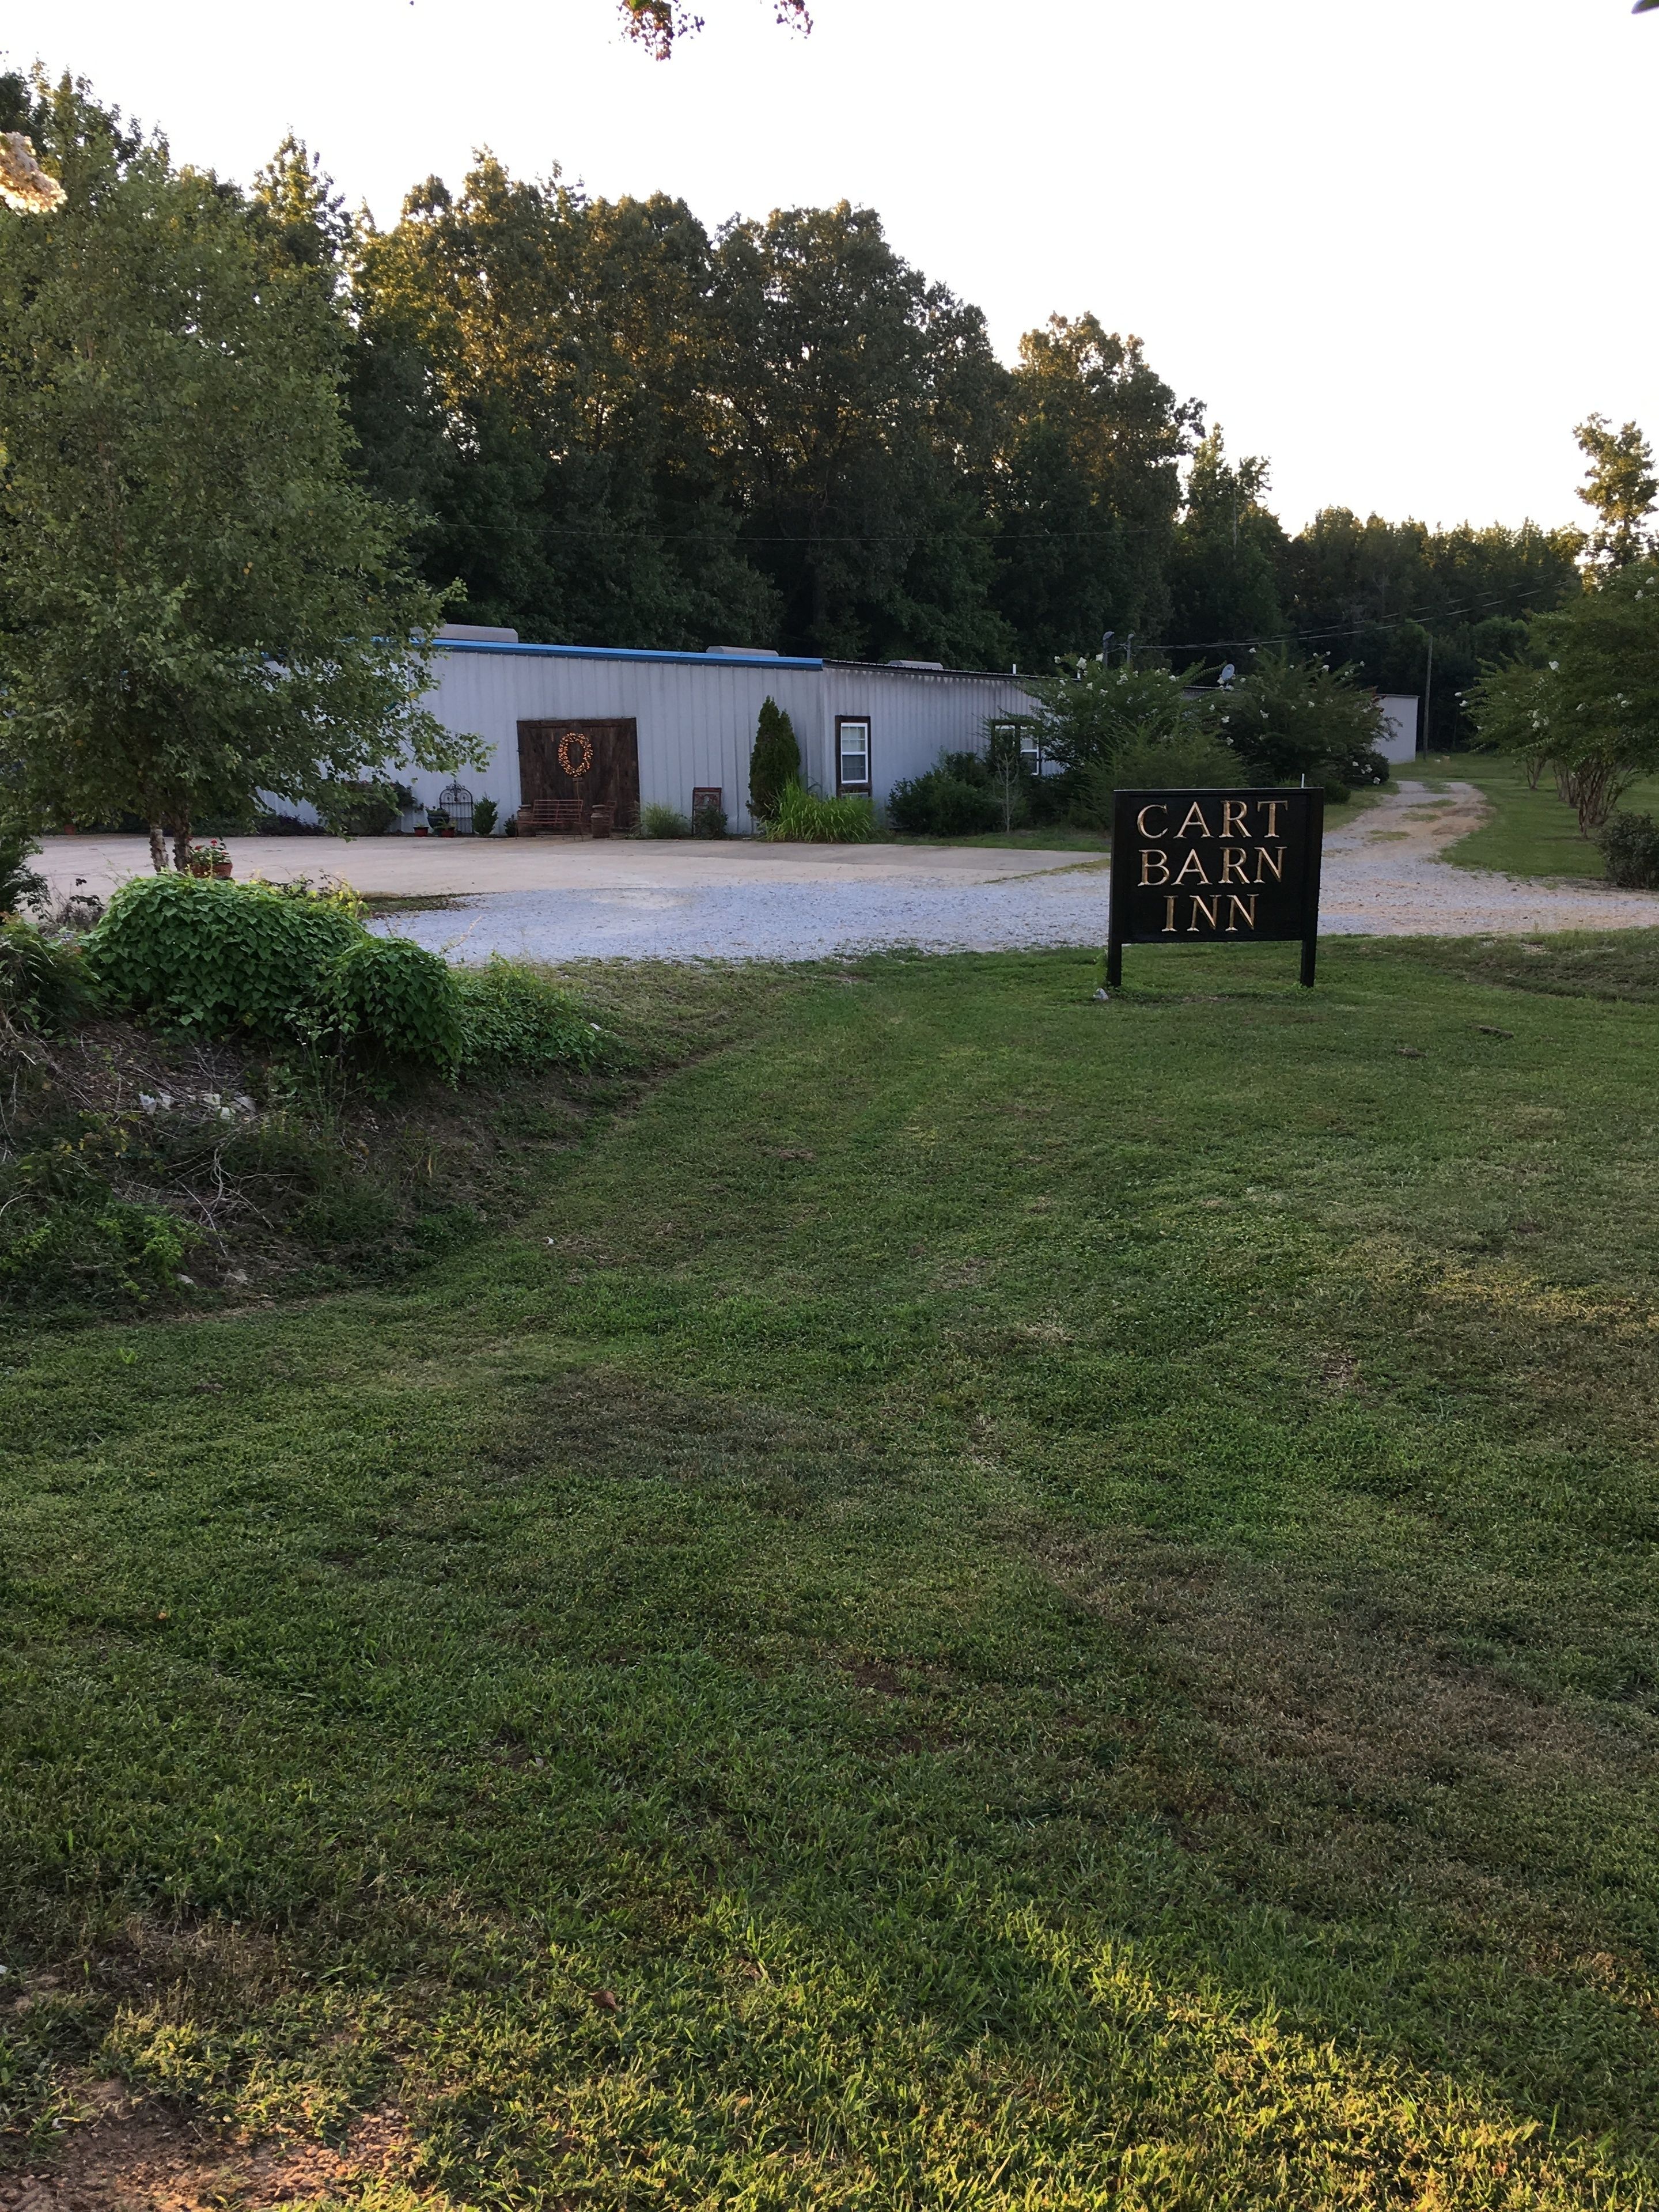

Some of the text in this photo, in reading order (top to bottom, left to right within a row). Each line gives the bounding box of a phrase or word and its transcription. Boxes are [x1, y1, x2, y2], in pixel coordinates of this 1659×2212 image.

[1137, 800, 1288, 839] CART
[1137, 846, 1287, 887] BARN
[1161, 893, 1260, 932] INN
